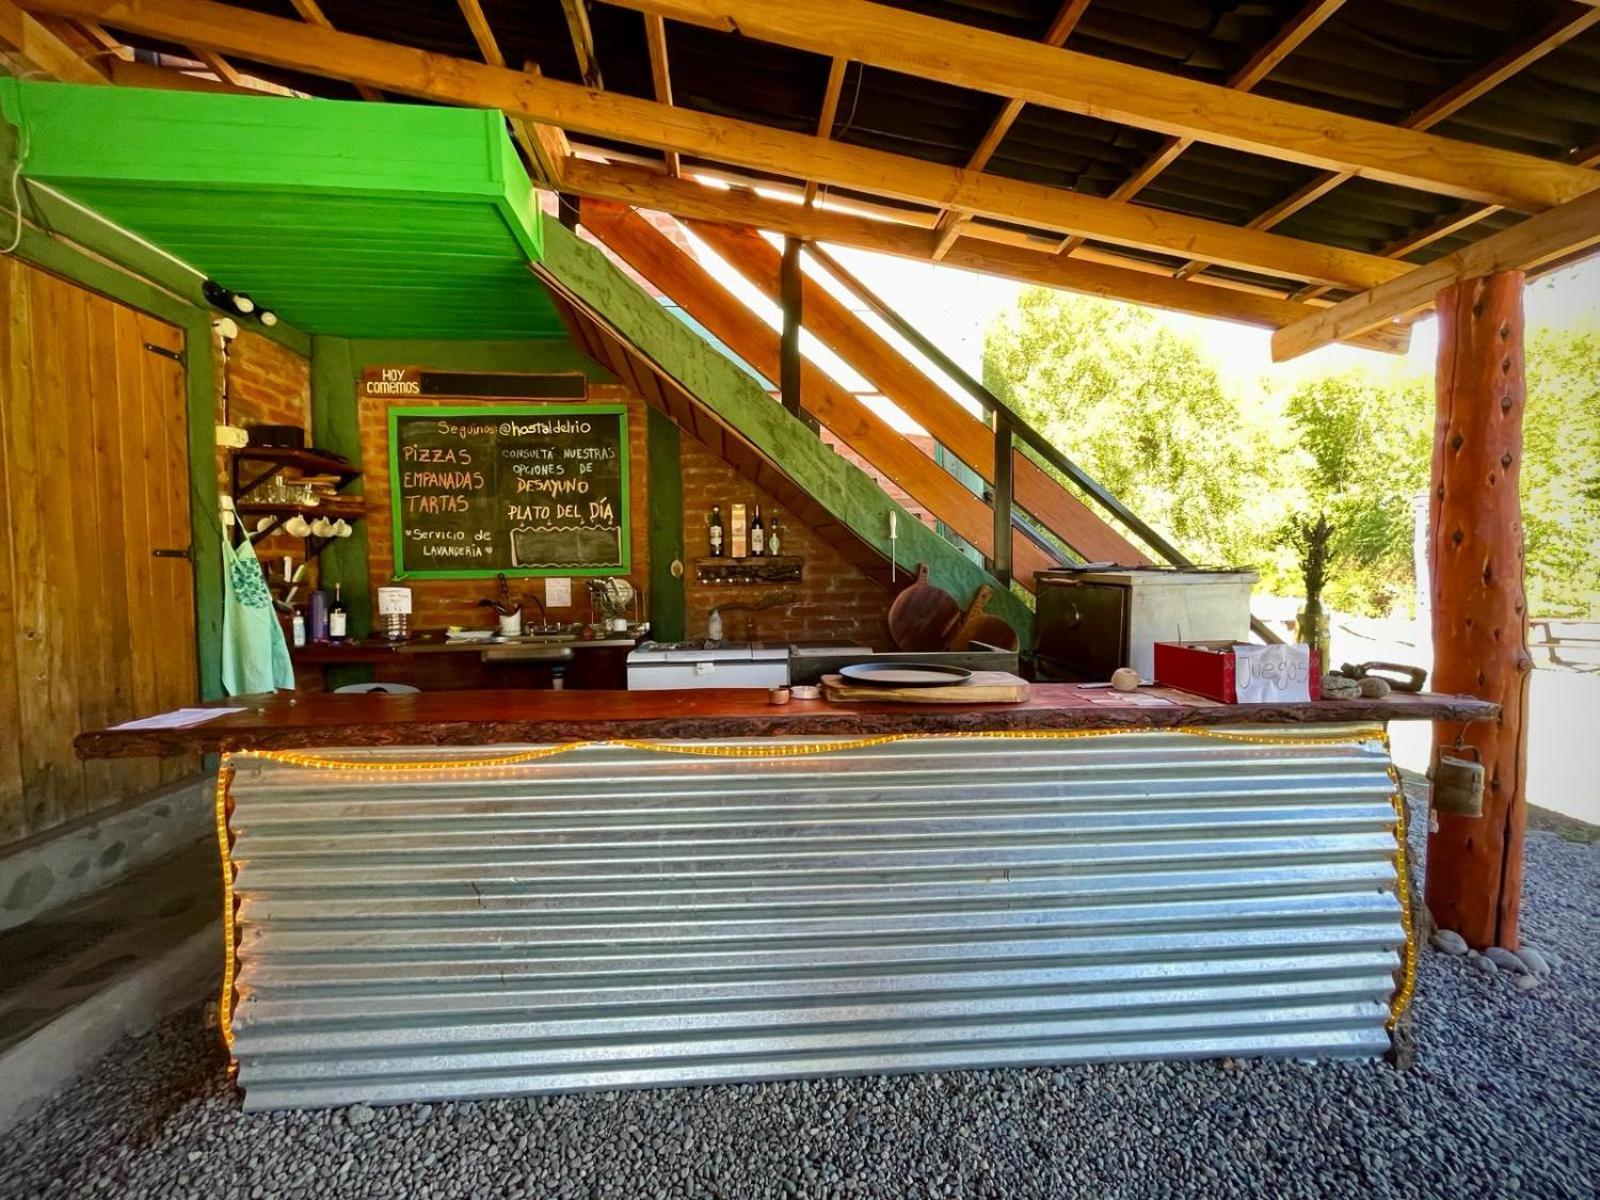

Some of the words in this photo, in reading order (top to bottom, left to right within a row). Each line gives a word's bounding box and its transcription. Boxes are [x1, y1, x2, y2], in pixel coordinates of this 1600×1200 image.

[382, 368, 405, 381] HOY
[499, 420, 591, 437] @hostaldelrio
[563, 447, 616, 460] NUESTRAS
[512, 463, 565, 476] OPCIONES
[579, 462, 593, 474] DE
[403, 471, 484, 491] EMPANADAS
[516, 477, 589, 498] DESAYUNO
[404, 494, 469, 514] TARTAS
[507, 504, 550, 521] PLATO
[556, 503, 582, 519] DEL
[588, 496, 614, 521] DÍA
[412, 528, 465, 541] Servicio
[474, 529, 492, 541] de
[1238, 656, 1308, 691] Juegos
